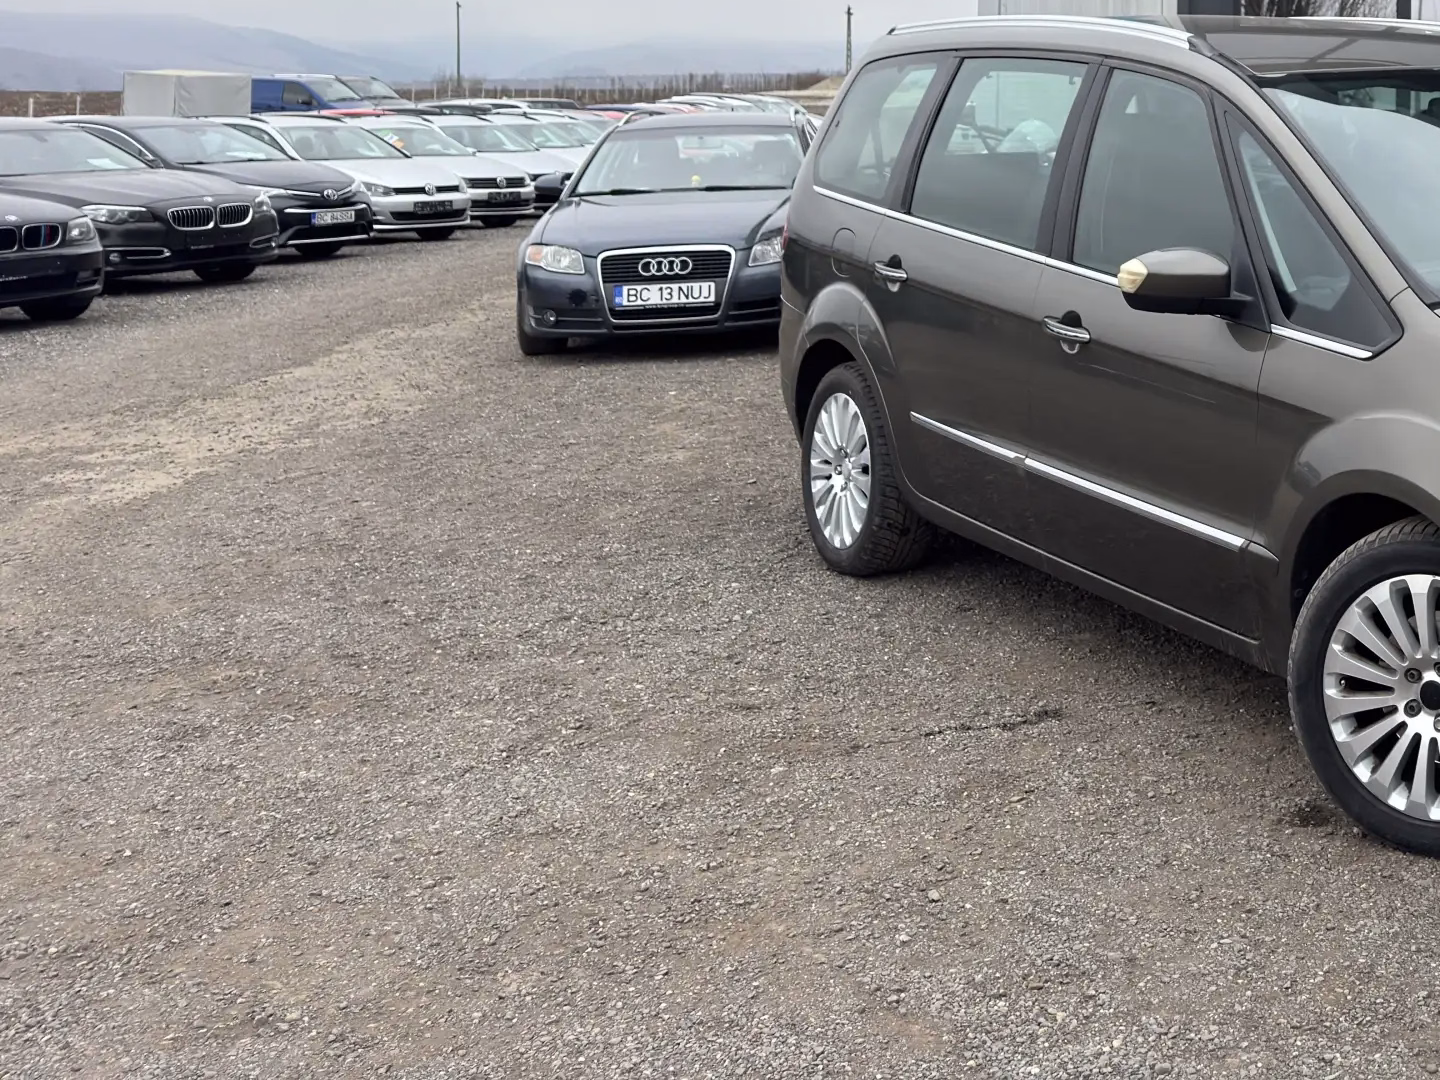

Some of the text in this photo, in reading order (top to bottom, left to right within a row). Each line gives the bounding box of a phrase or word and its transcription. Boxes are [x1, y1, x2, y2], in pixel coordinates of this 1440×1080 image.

[627, 287, 651, 303] BC
[658, 286, 674, 301] 13
[678, 284, 712, 301] NUJ
